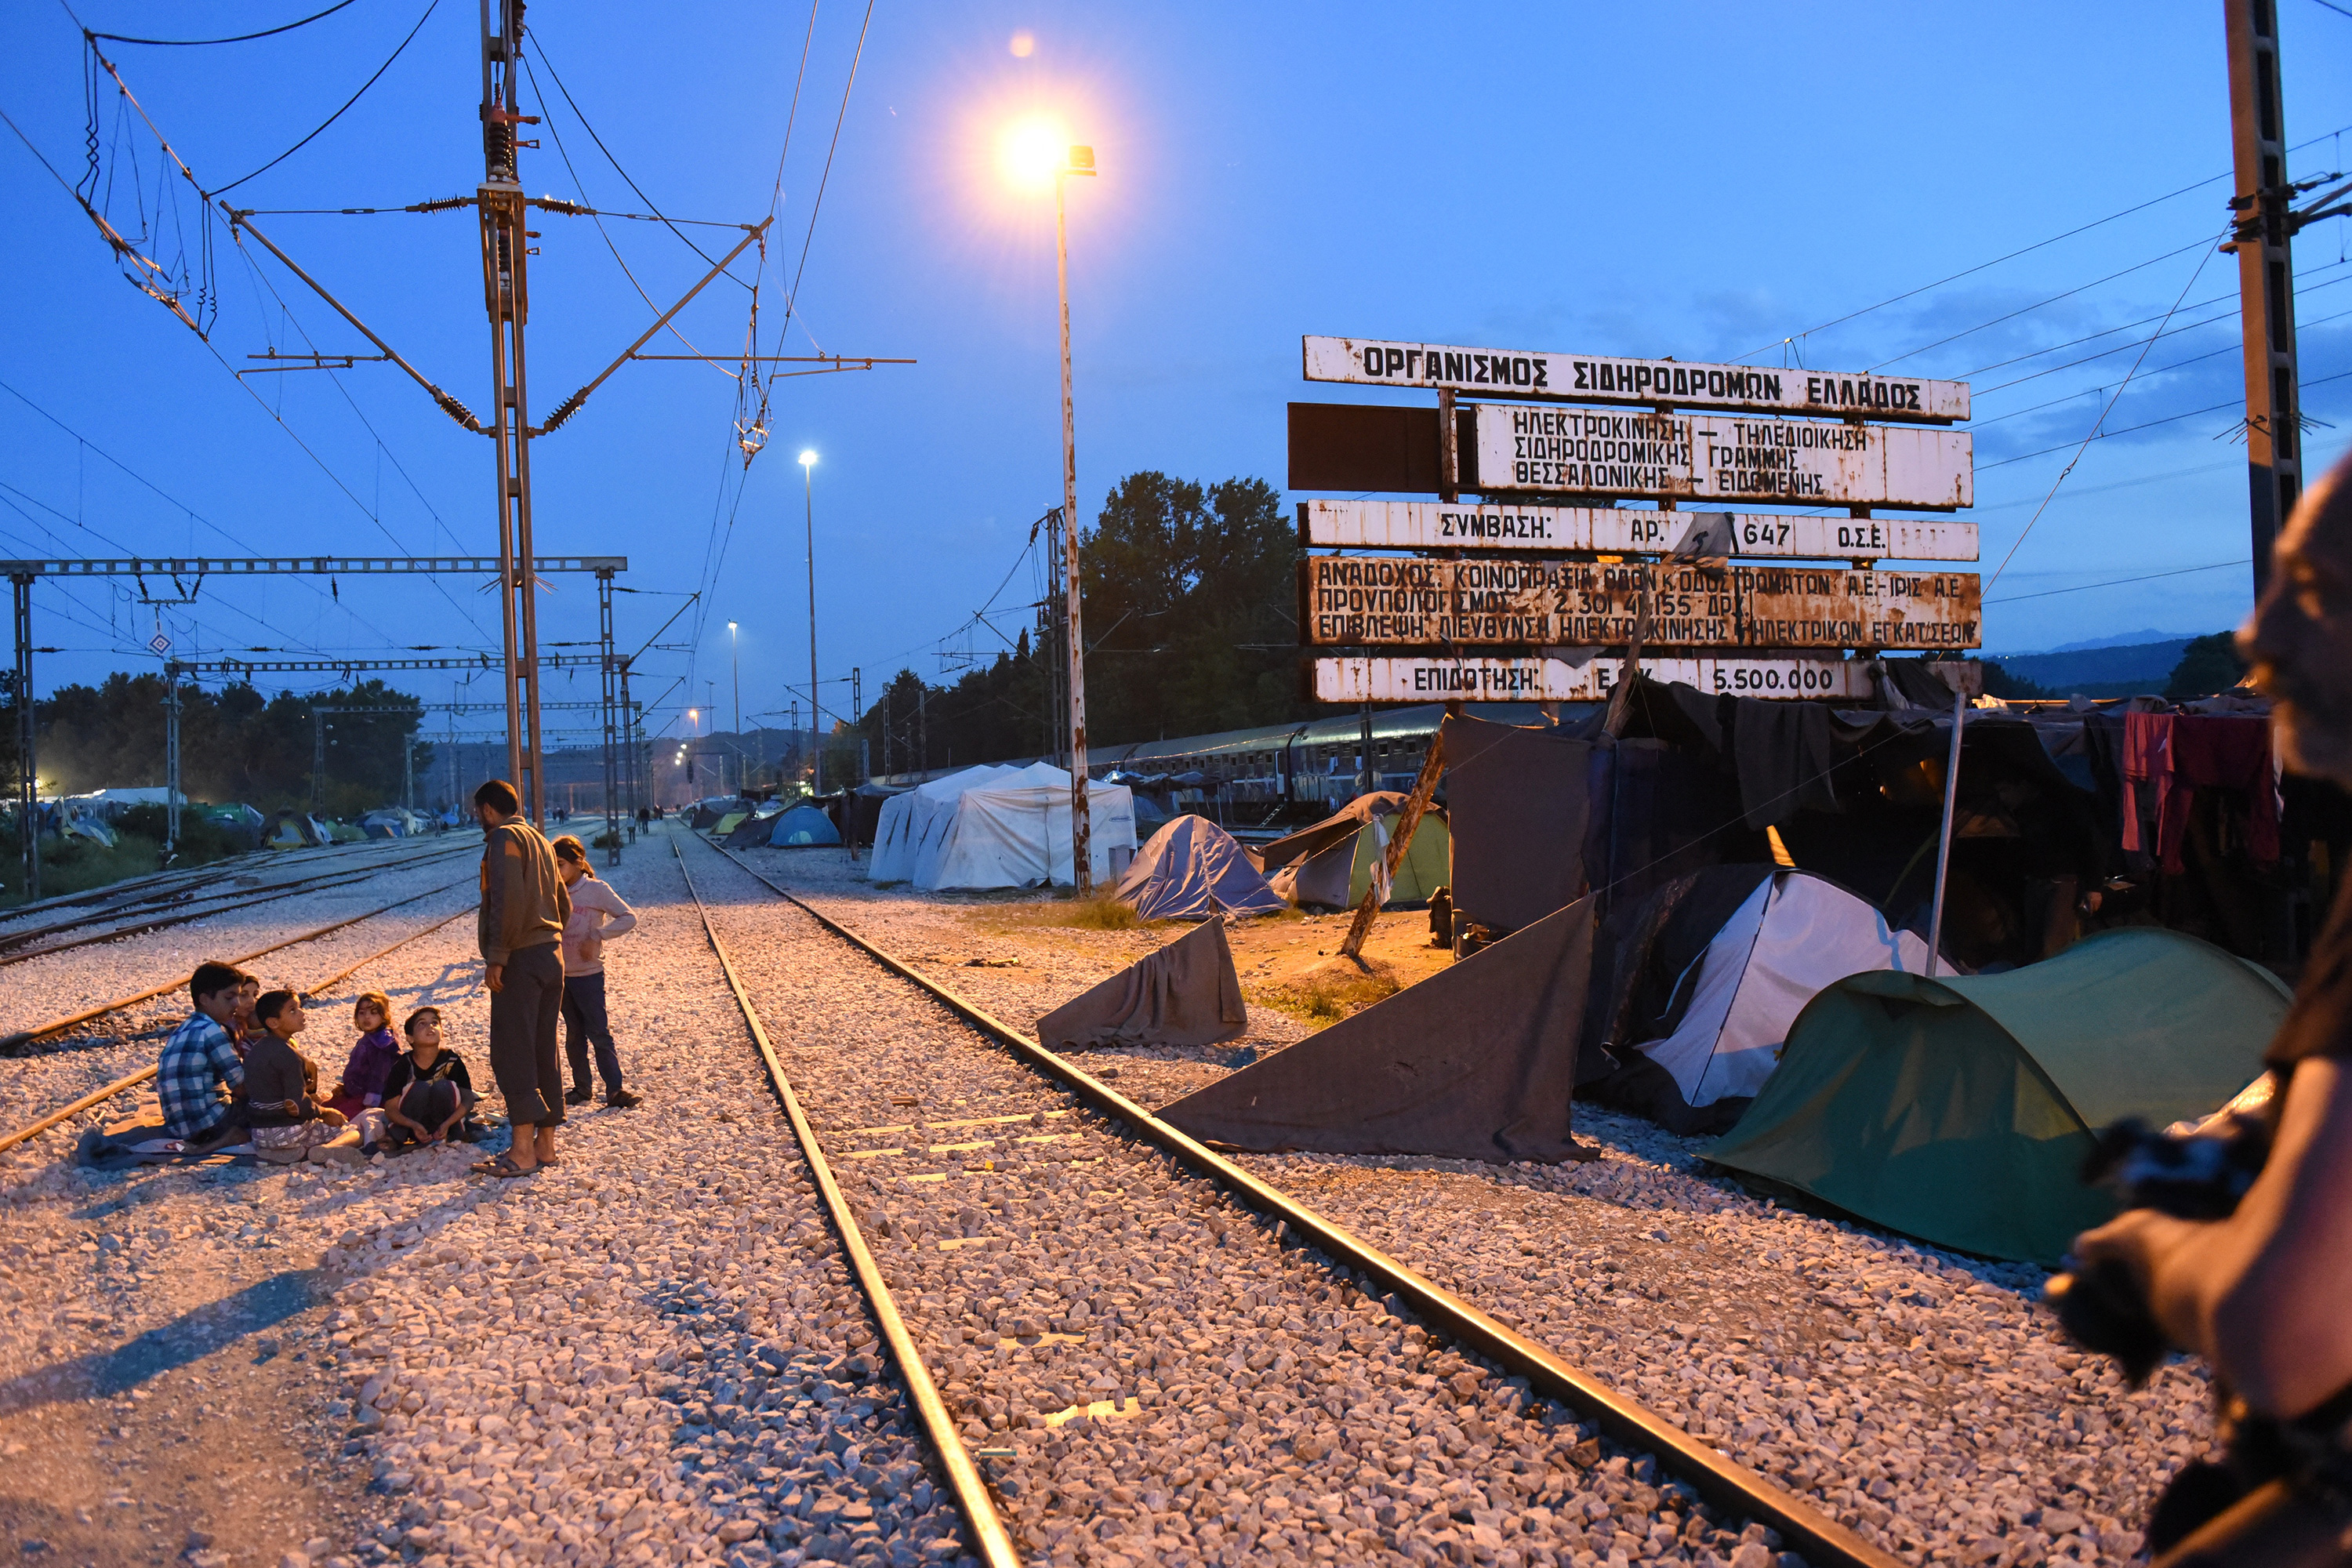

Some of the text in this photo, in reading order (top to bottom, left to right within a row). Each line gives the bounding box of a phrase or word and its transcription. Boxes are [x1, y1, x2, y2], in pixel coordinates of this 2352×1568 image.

[1363, 347, 1921, 410] ΟΡΓΑΝΙΣΜΟΣ ΣΙΔΗΡΟΔΡΟΜΩΝ ΕΛΛΑΔΟΣ
[1514, 412, 1684, 442] ΗΛΕΚΤΡΟΚΙΝΗΣΗ
[1733, 423, 1867, 451] ΤΗΛΕΔΙΟΙΚΗΣΗ
[1515, 437, 1798, 470] ΣΙΔΗΡΟΔΡΟΜΙΚΗΣ ΓΡΑΜΜΗΣ
[1515, 462, 1669, 489] ΘΕΣΣΑΛΟΝΙΚΗΣ
[1719, 470, 1823, 495] ΕΙΔΟΜΕΝΗΣ
[1631, 520, 1664, 542] ΑΡ.
[1744, 524, 1790, 546] 647
[1838, 527, 1886, 549] Ο.Σ.Ε.
[1318, 563, 1443, 587] ΑΝΑΔΟΧΟΣ:
[1454, 565, 1592, 590] ΚΟΙΝΟΠΡΑΞΙΑ
[1319, 615, 1429, 637] ΕΠΙΒΛΕΨΗ:
[1560, 617, 1728, 641] ΗΛΕΚΤΡΚΙΝΗΣΗΣ
[1754, 619, 1861, 641] ΗΛΕΚΤΡΙΚΩΝ
[1414, 667, 1833, 691] ΕΠΙΔΟΤΗΣΗ: 5.500.000
